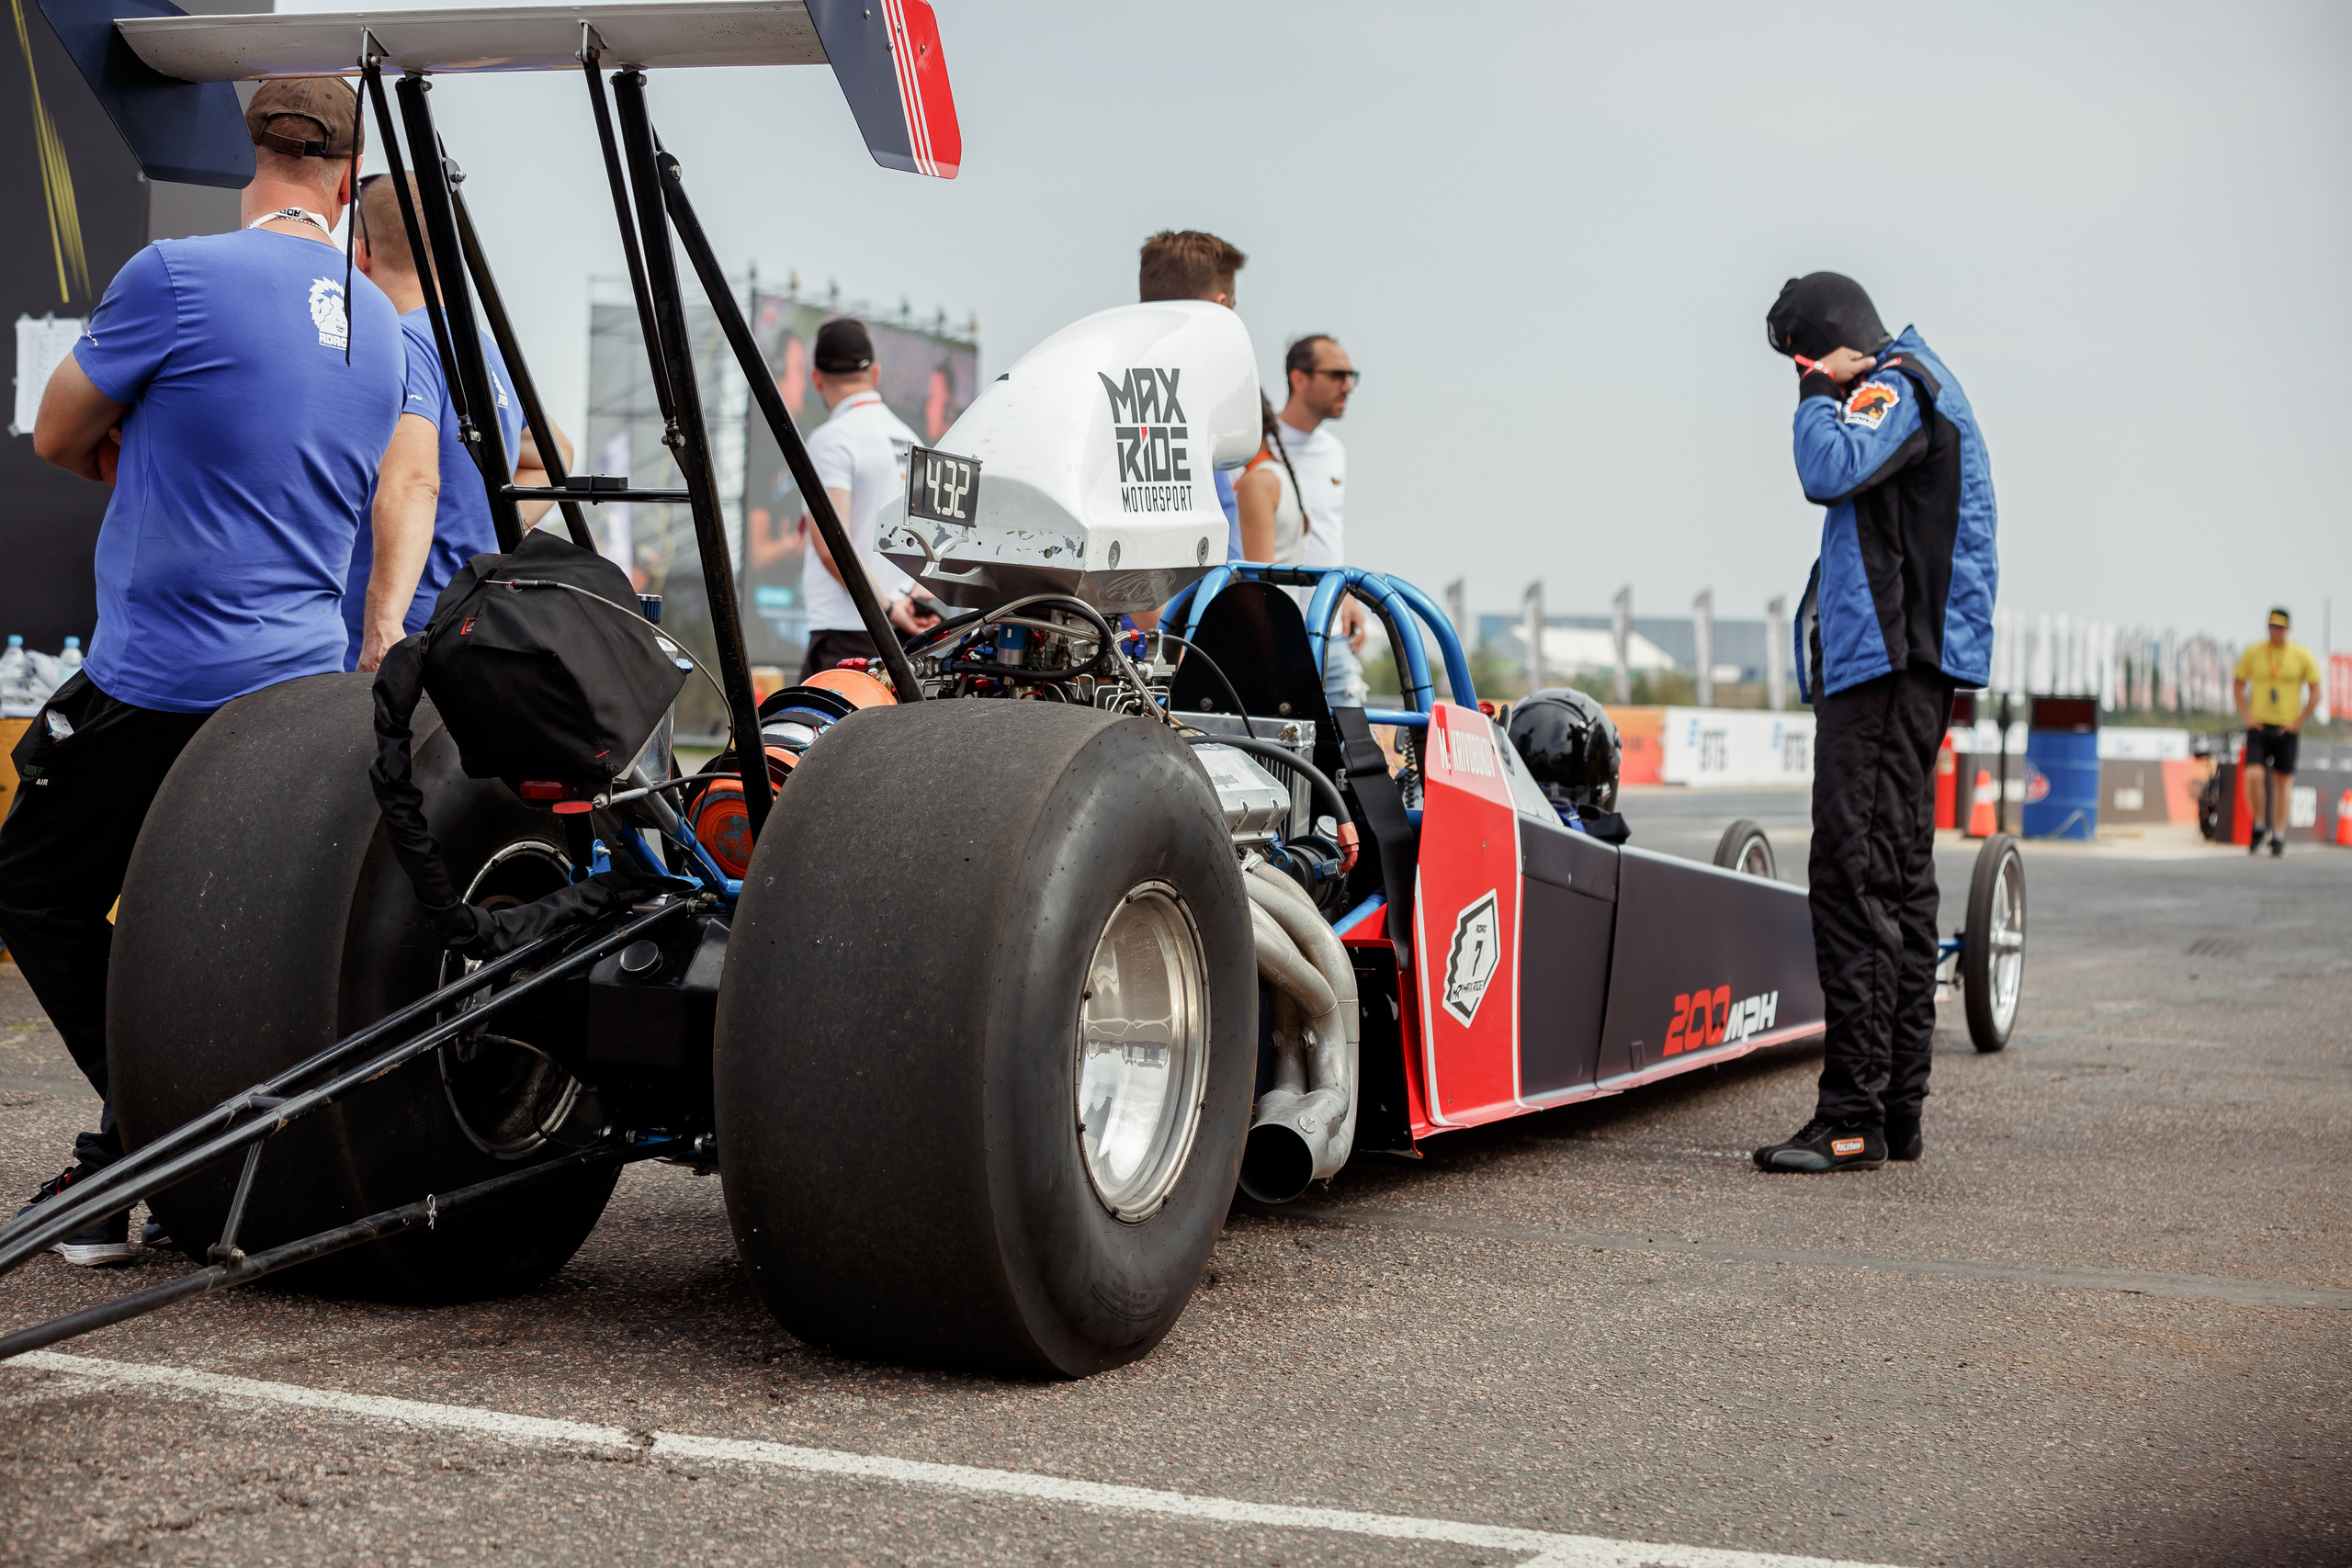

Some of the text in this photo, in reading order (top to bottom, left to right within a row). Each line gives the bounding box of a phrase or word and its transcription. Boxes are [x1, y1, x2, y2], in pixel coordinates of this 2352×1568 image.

[1097, 367, 1187, 424] MAX
[1115, 426, 1192, 483] RIDE
[925, 457, 972, 520] 4.32
[1120, 485, 1193, 513] MOTORSPORT
[1437, 726, 1452, 770] M.
[35, 778, 49, 786] AIR
[1472, 940, 1484, 976] 7
